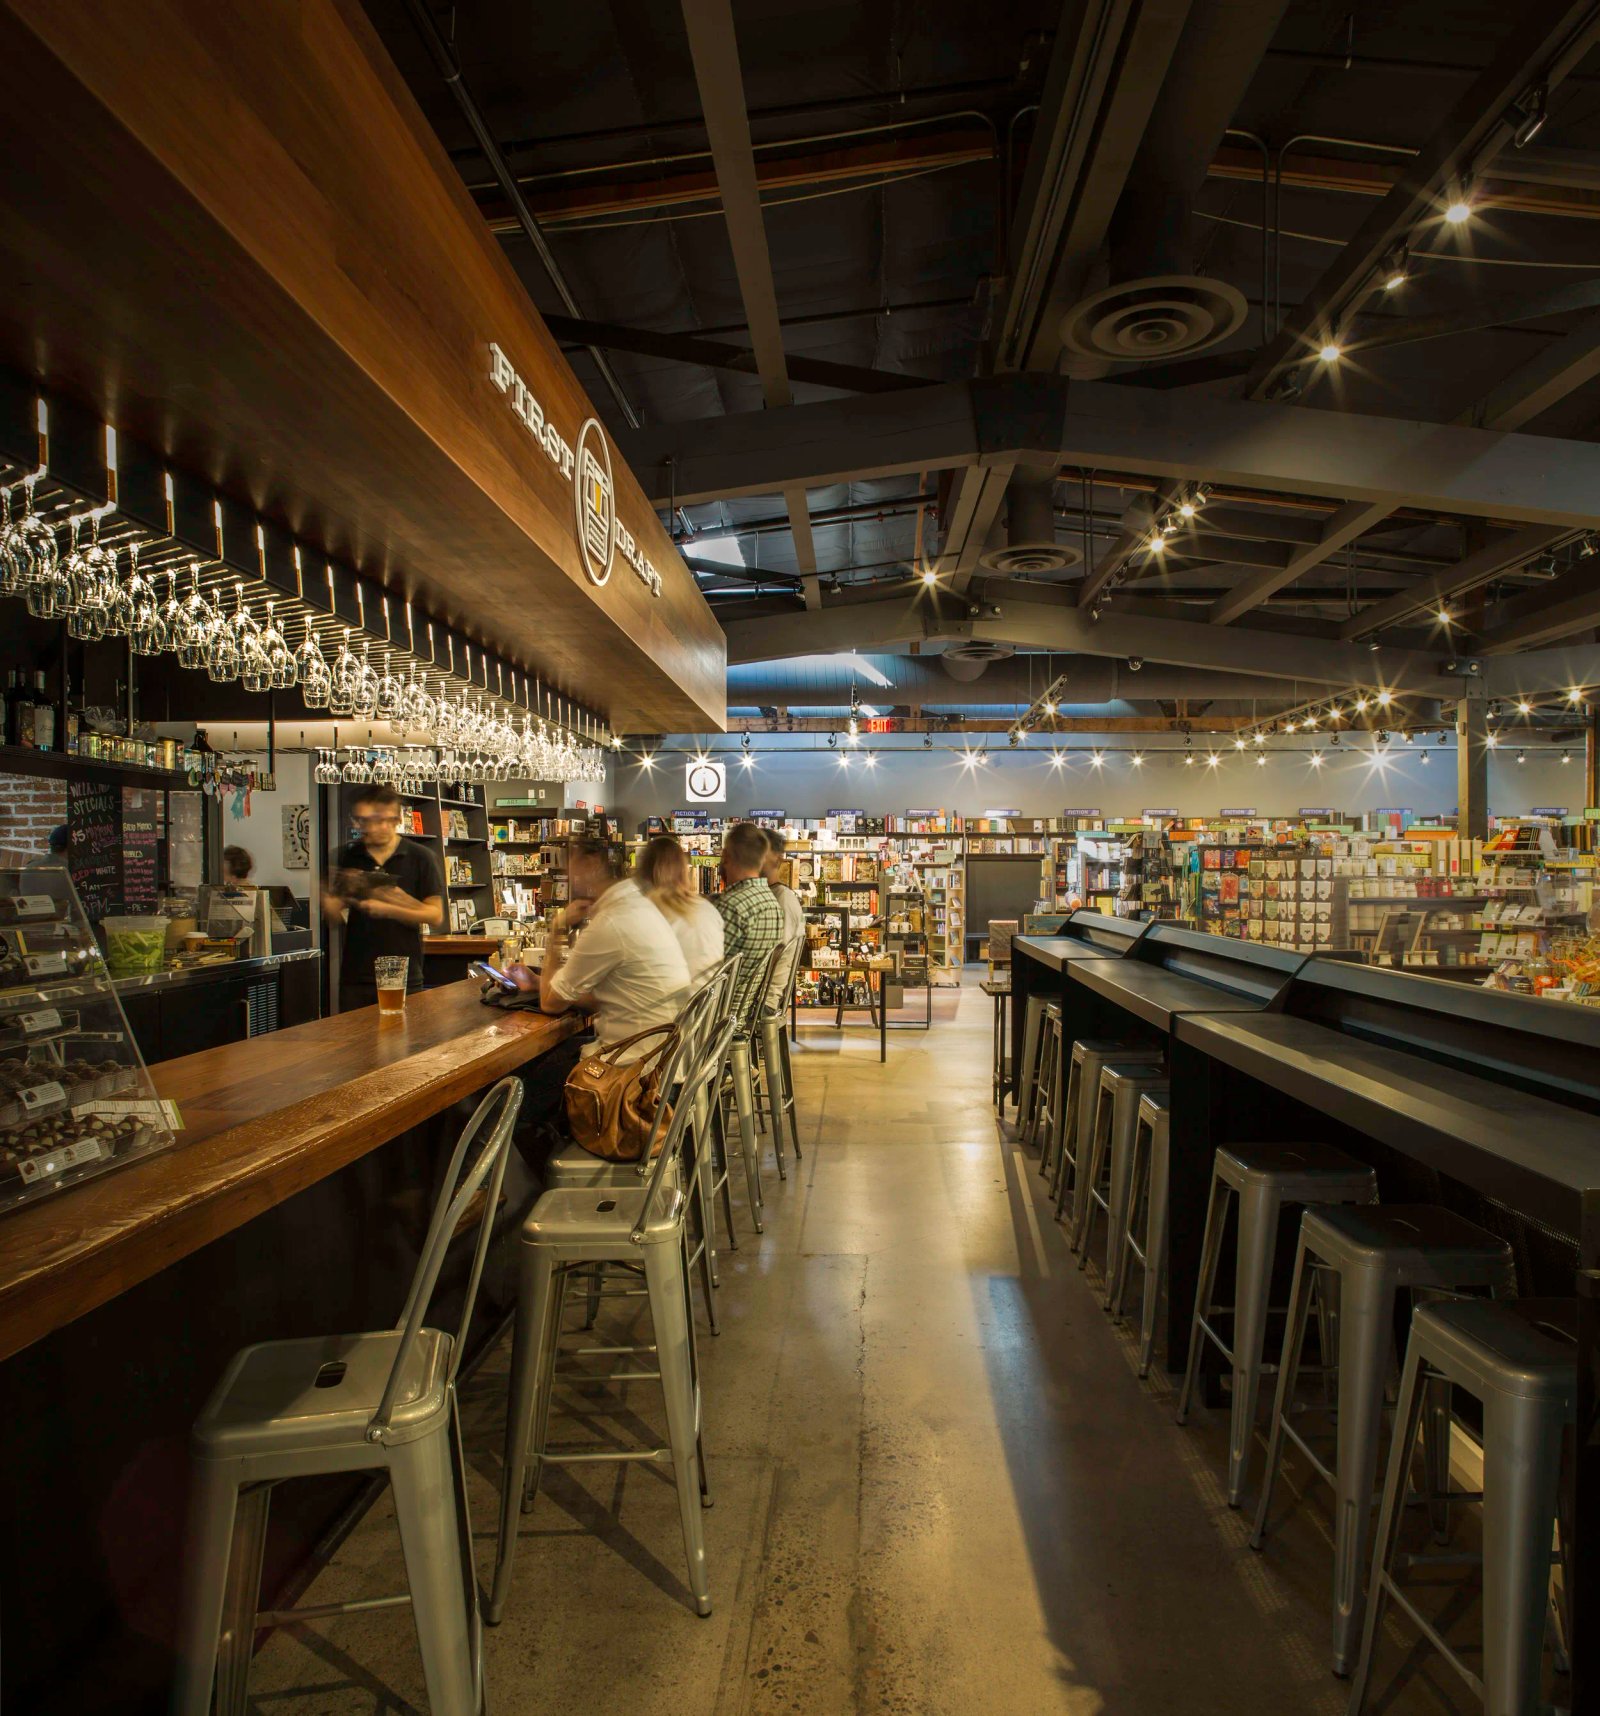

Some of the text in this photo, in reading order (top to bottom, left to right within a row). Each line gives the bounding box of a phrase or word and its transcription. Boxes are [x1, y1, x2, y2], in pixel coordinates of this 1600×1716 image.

[490, 343, 662, 597] FIRST DRAFT
[871, 719, 887, 732] EXIT
[73, 796, 114, 815] SPECIALS
[72, 828, 86, 845] $5
[95, 865, 116, 875] WHITE
